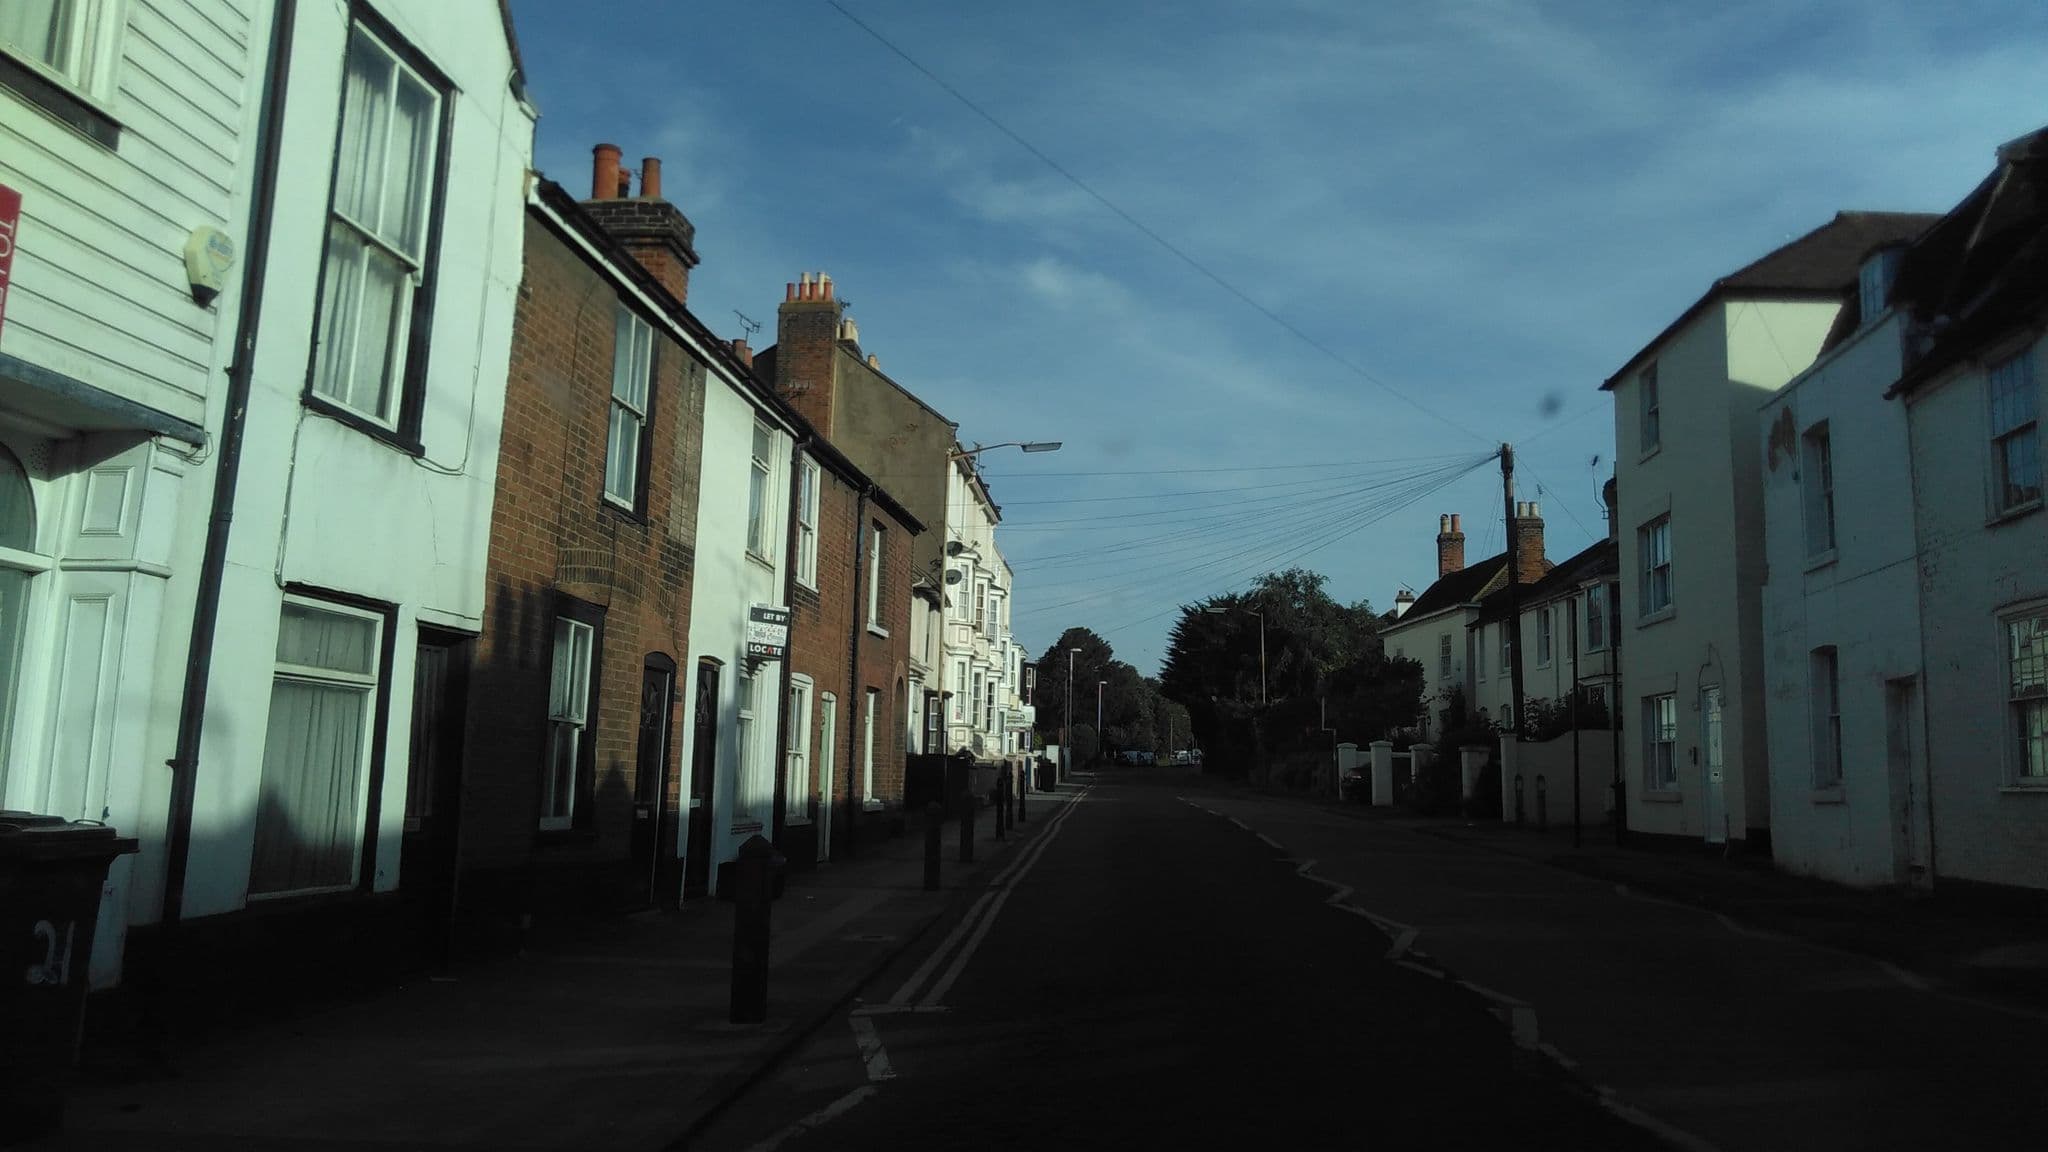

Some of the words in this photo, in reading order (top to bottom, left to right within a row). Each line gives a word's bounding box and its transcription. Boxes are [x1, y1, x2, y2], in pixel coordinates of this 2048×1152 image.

[763, 612, 775, 620] LET
[775, 614, 786, 622] BY
[749, 643, 783, 655] LOCATE
[26, 920, 76, 985] 21
